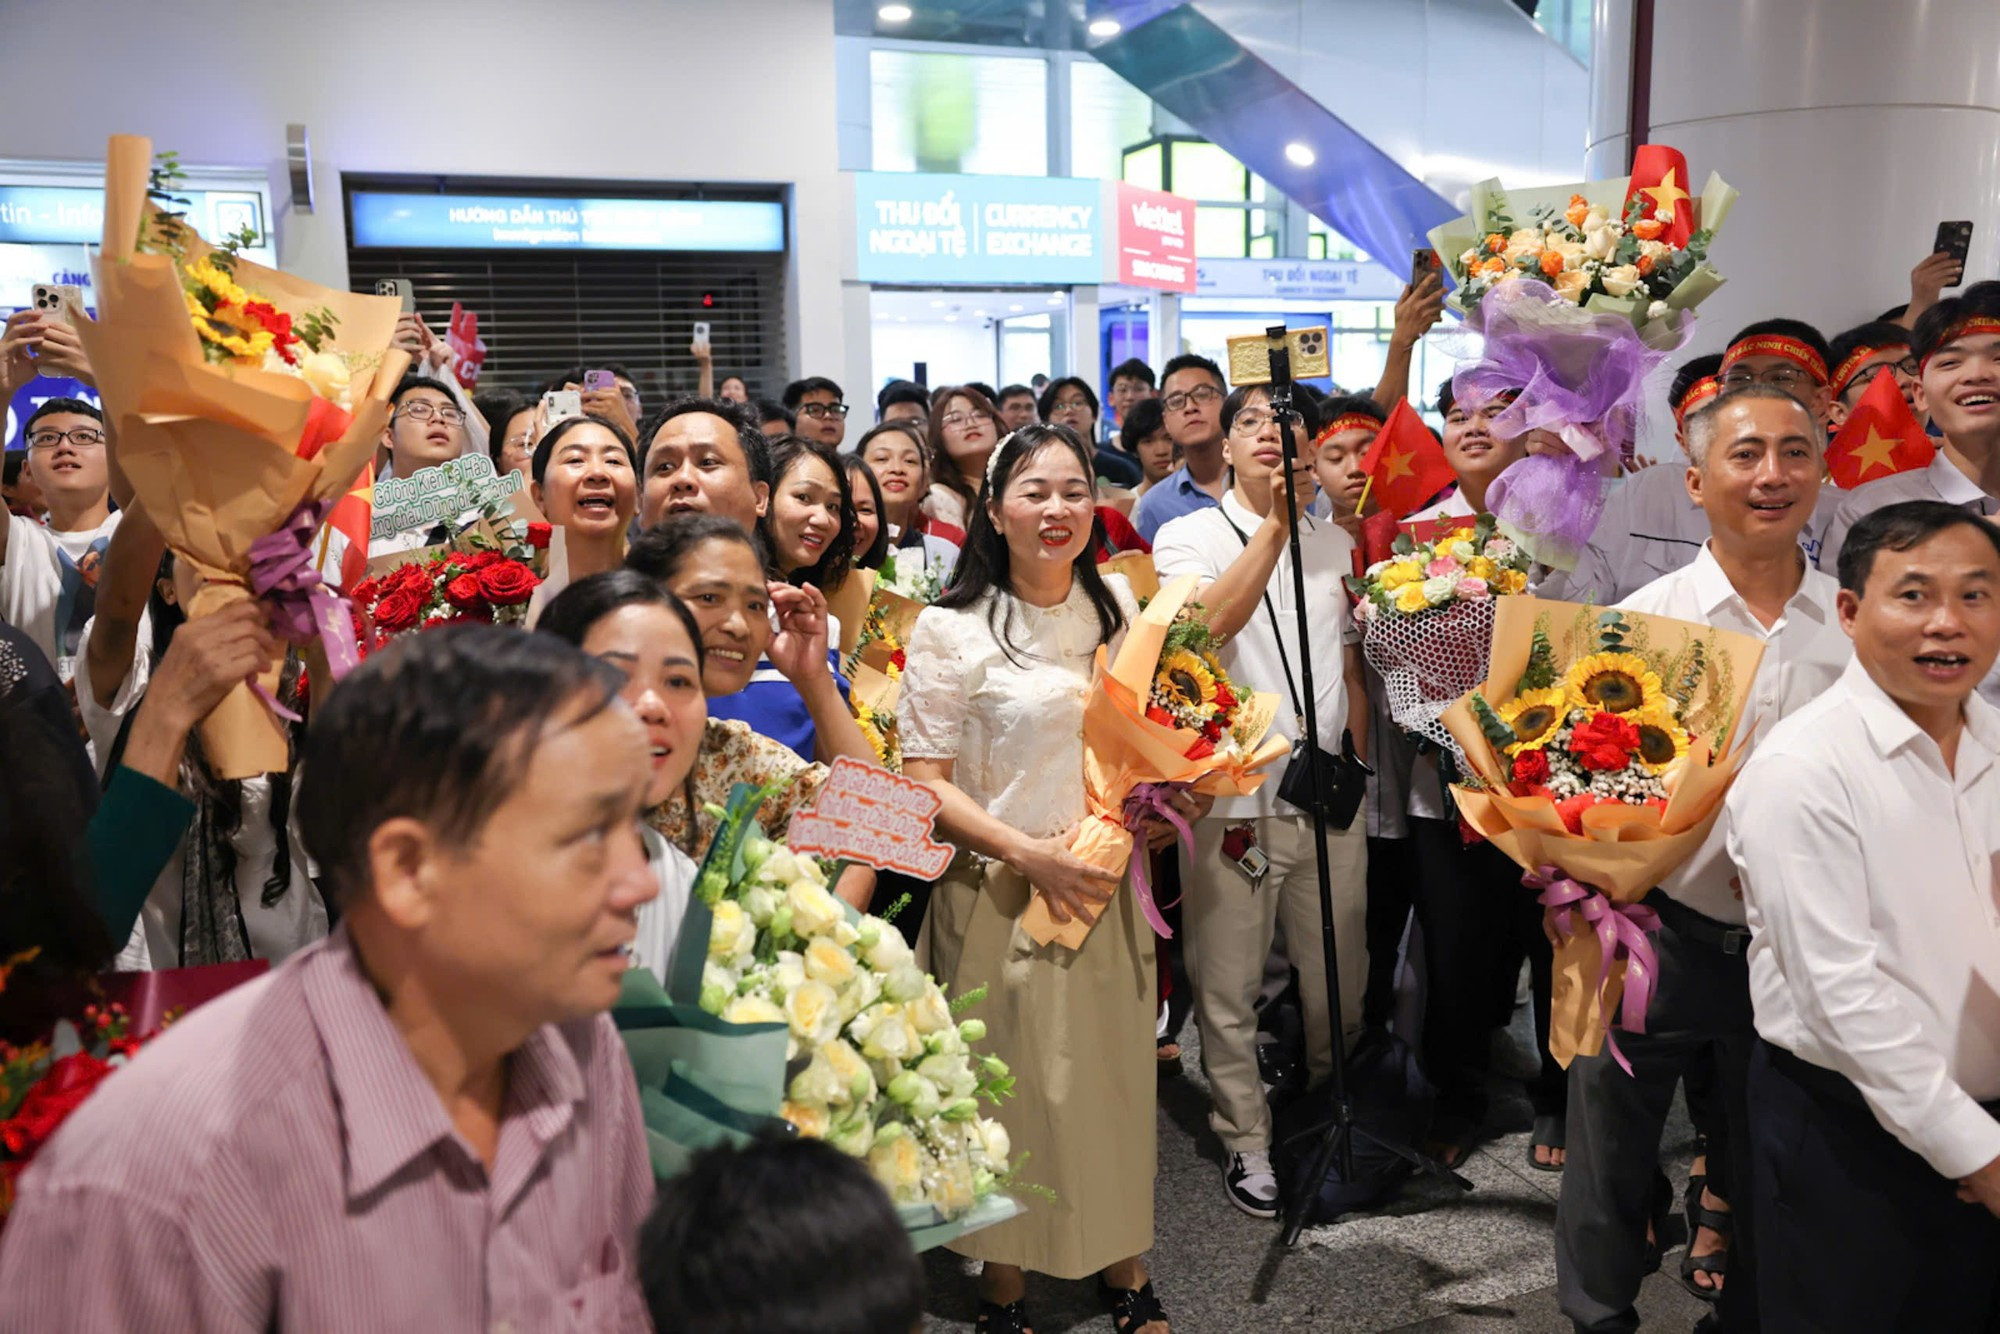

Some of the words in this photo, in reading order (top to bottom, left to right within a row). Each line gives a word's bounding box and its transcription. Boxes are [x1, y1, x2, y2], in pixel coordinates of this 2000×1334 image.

[1, 202, 31, 225] tin
[875, 200, 920, 226] THU
[984, 203, 1093, 229] CURRENCY
[987, 231, 1093, 257] EXCHANGE
[1756, 341, 1782, 350] NINH
[464, 457, 489, 478] Hảo
[394, 505, 422, 529] cháu
[424, 498, 457, 519] Dũng
